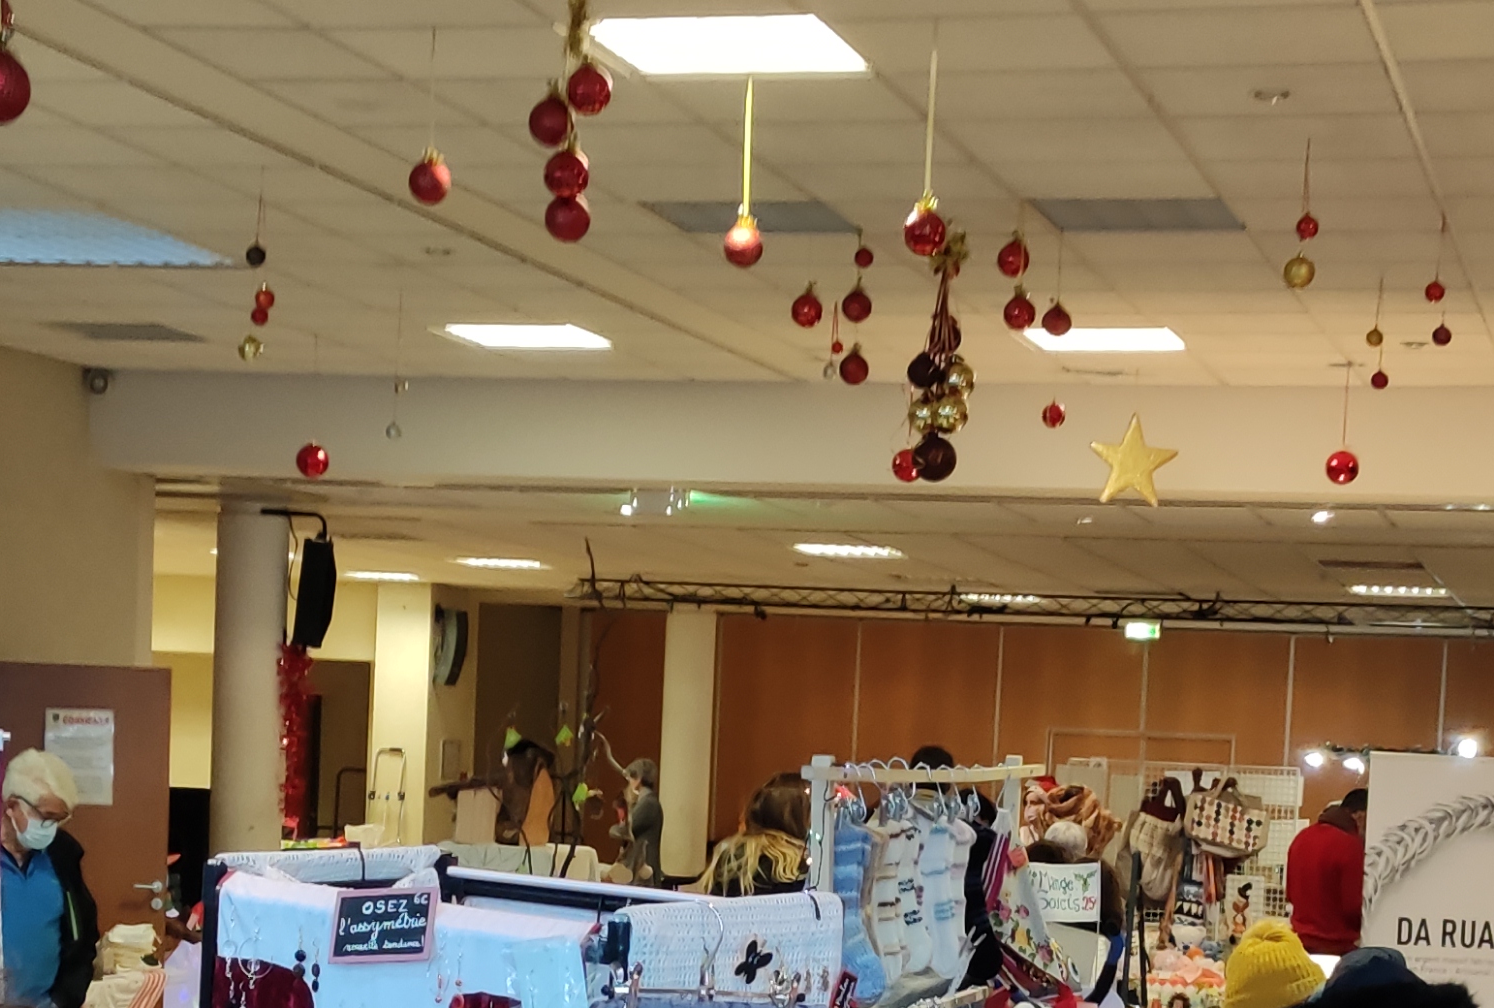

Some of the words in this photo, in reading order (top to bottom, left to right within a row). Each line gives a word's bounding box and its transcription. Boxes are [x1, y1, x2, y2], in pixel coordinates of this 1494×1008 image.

[362, 899, 408, 914] OSEZ
[1397, 917, 1431, 946] DA
[1441, 918, 1494, 949] RUA
